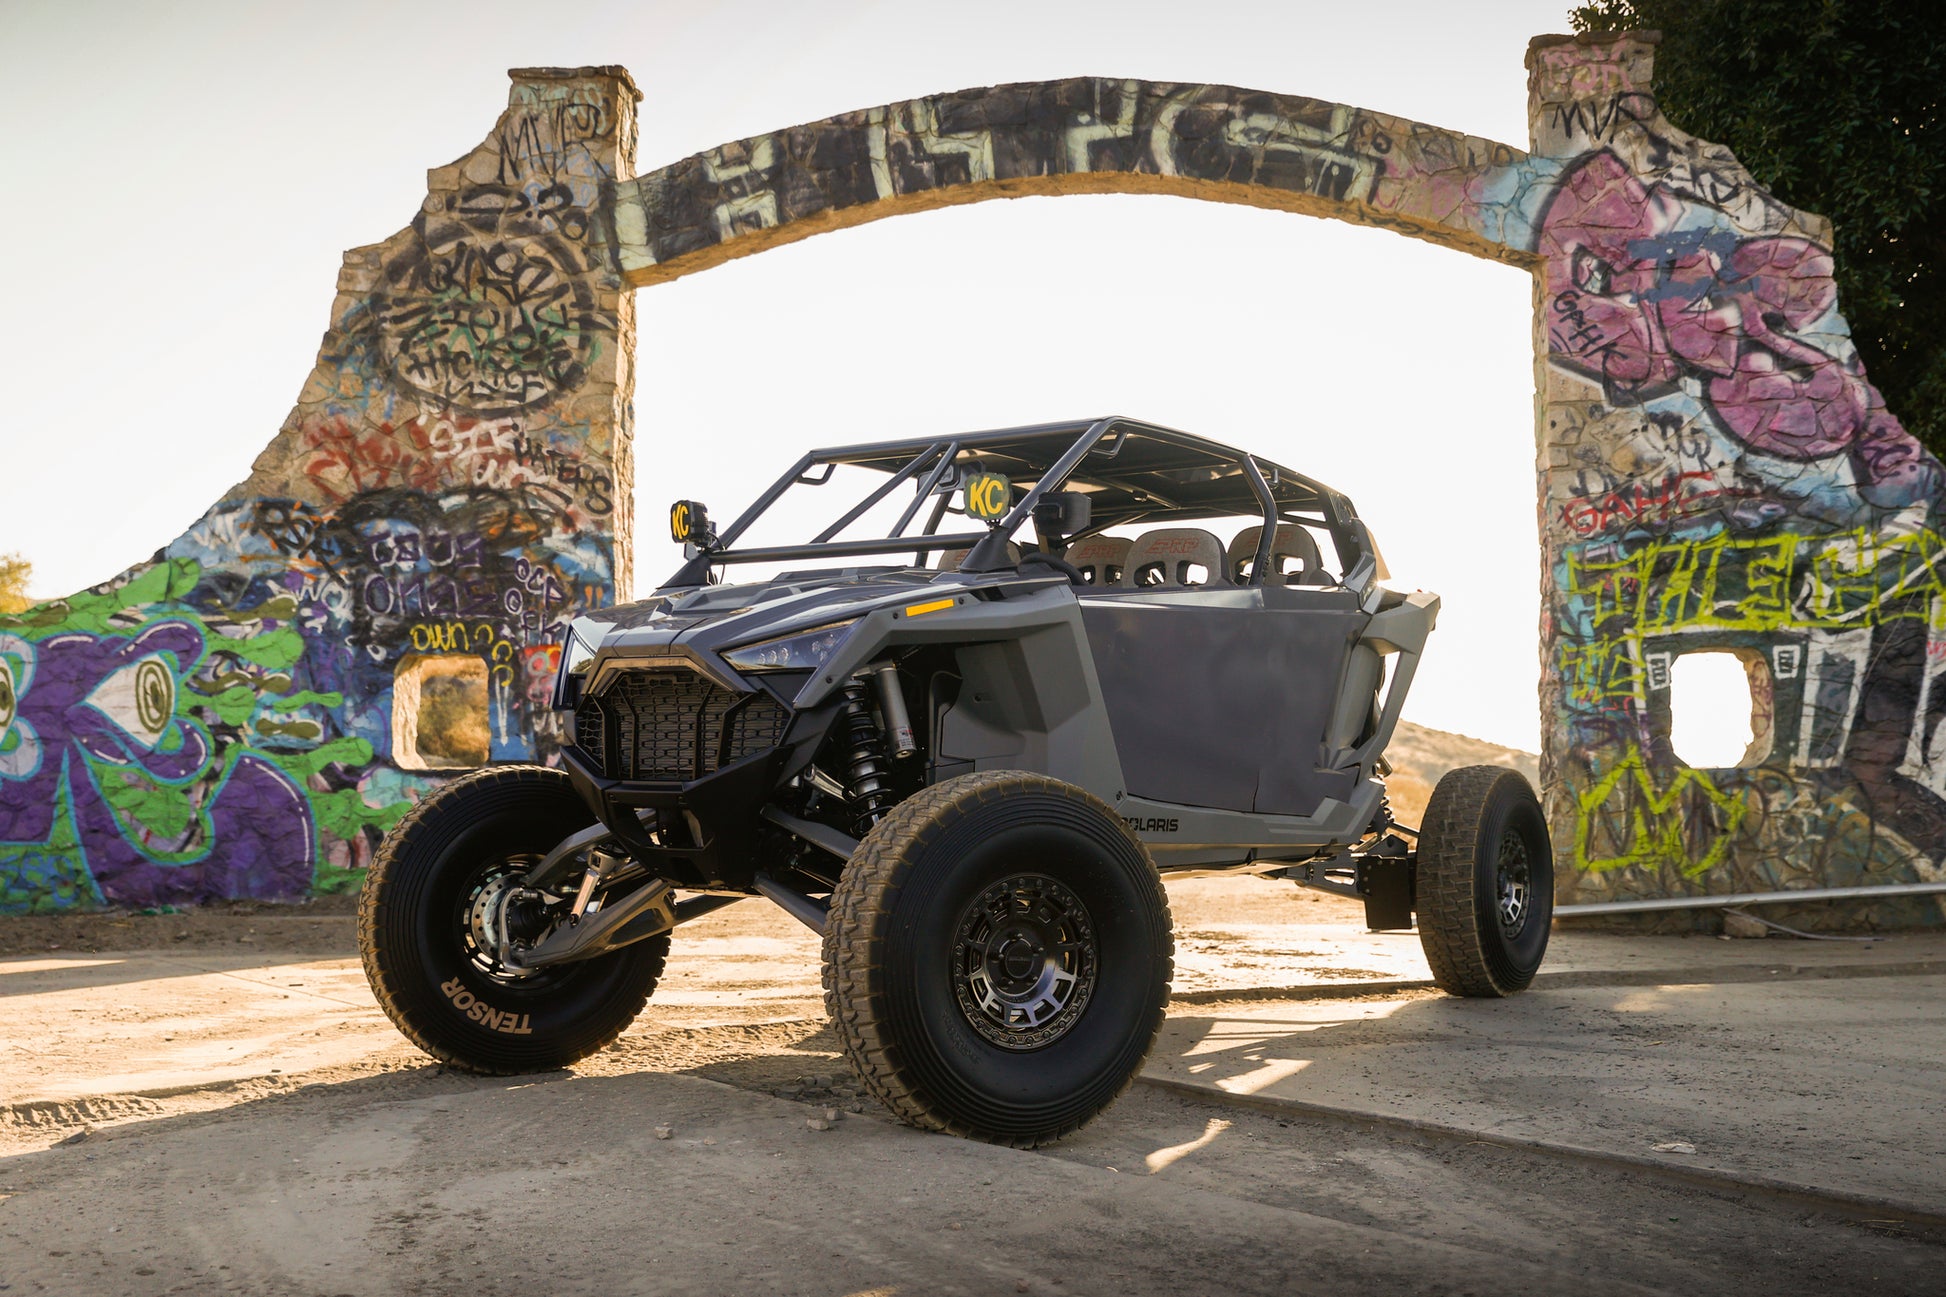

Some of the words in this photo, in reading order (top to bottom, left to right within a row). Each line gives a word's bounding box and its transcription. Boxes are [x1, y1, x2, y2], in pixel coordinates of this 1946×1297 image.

[969, 475, 1003, 517] KC
[672, 504, 689, 540] KC
[440, 976, 533, 1035] TENSOR
